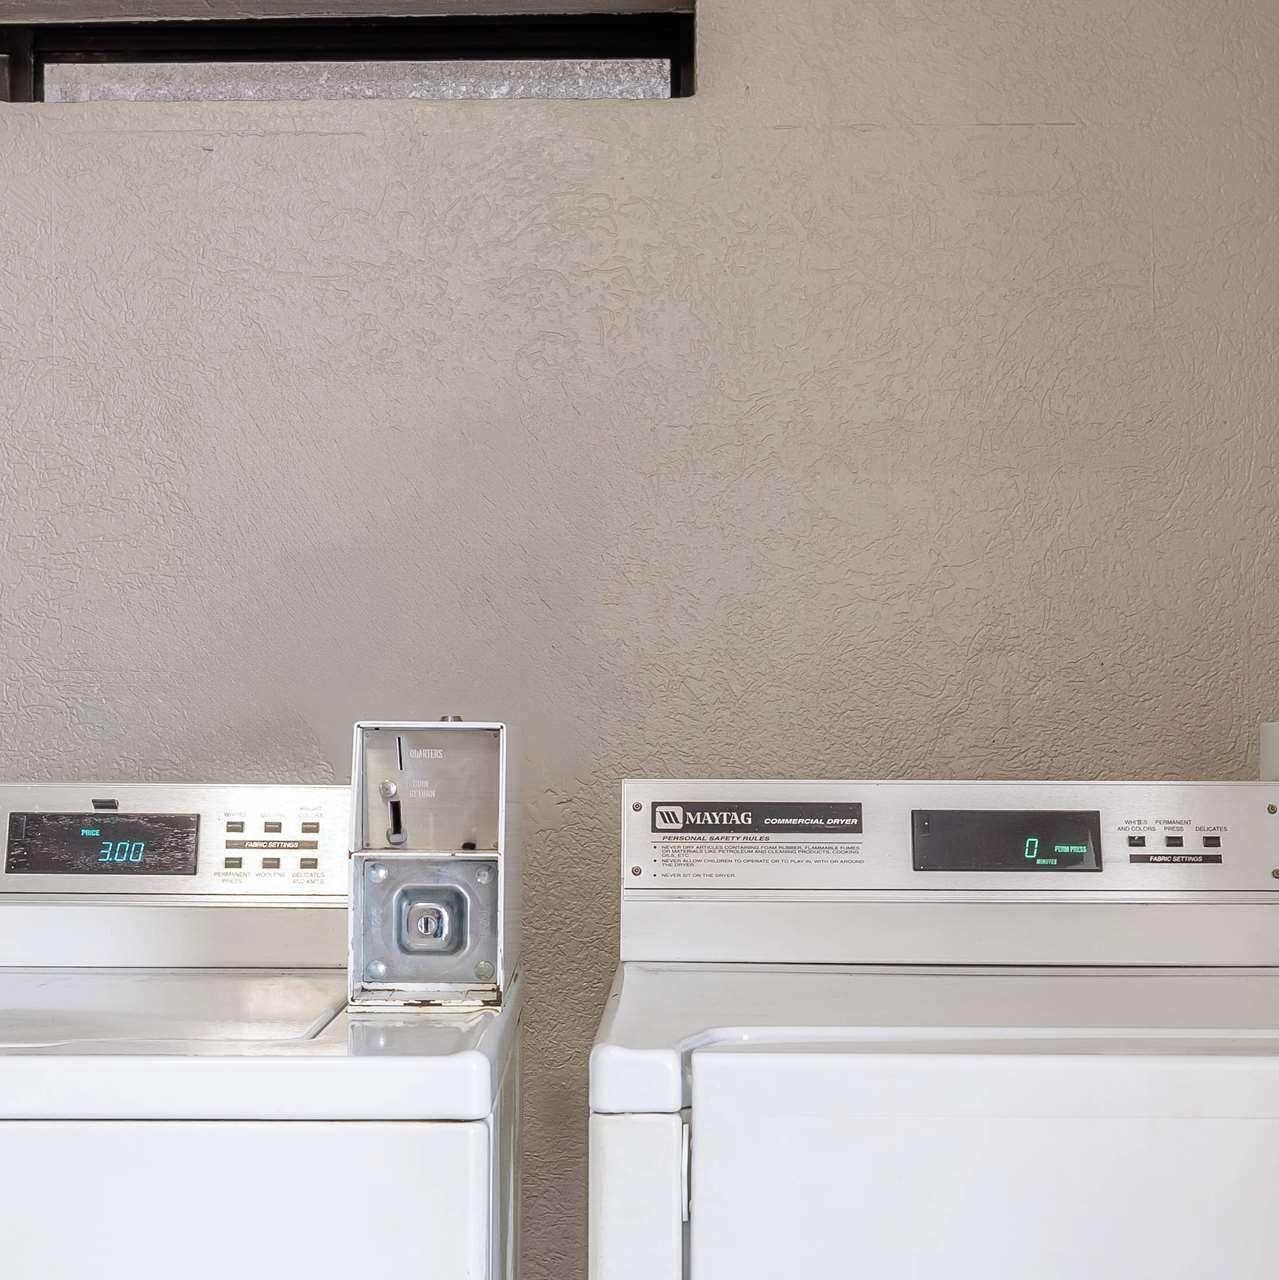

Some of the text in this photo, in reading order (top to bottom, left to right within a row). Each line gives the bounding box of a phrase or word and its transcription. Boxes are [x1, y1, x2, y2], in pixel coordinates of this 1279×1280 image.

[686, 812, 752, 824] MAYTAG
[98, 841, 145, 862] 3.00
[1025, 838, 1039, 858] 0
